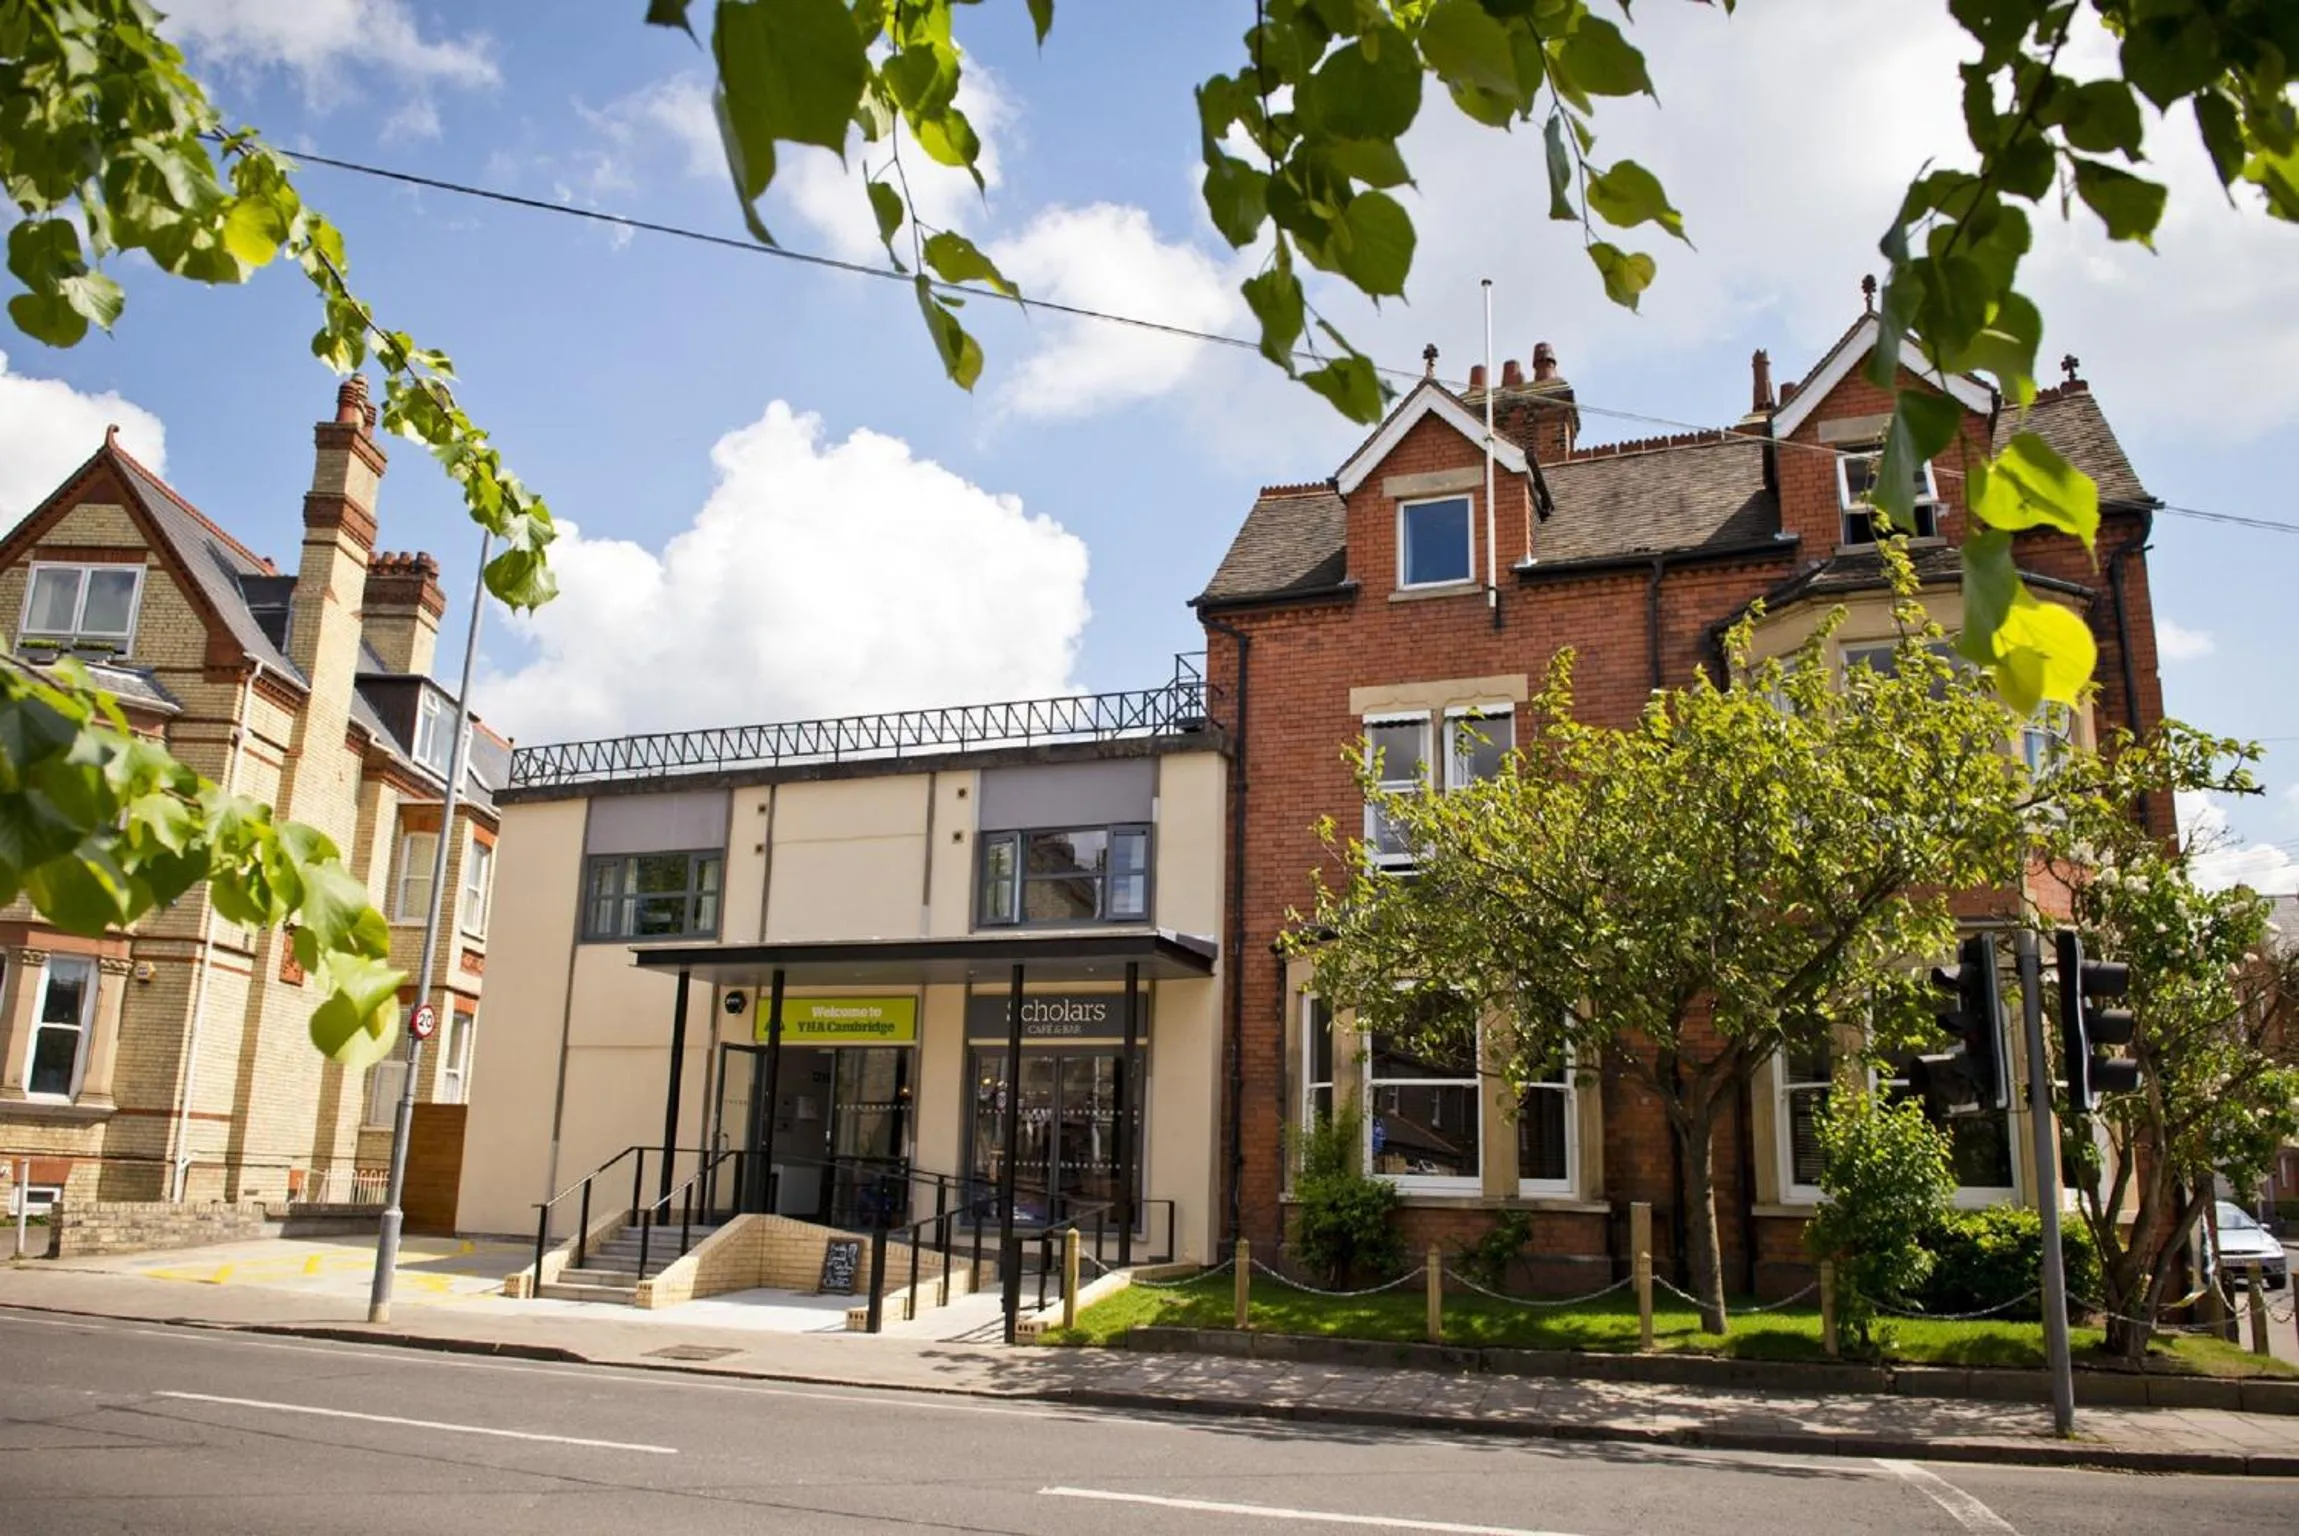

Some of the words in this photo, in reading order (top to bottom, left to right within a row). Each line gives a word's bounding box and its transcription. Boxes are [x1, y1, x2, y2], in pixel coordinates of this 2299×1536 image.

[812, 1006, 868, 1017] Welcome
[869, 1006, 882, 1017] to
[418, 1013, 432, 1028] 20
[797, 1021, 825, 1033] YHA
[827, 1021, 895, 1036] Cambridge
